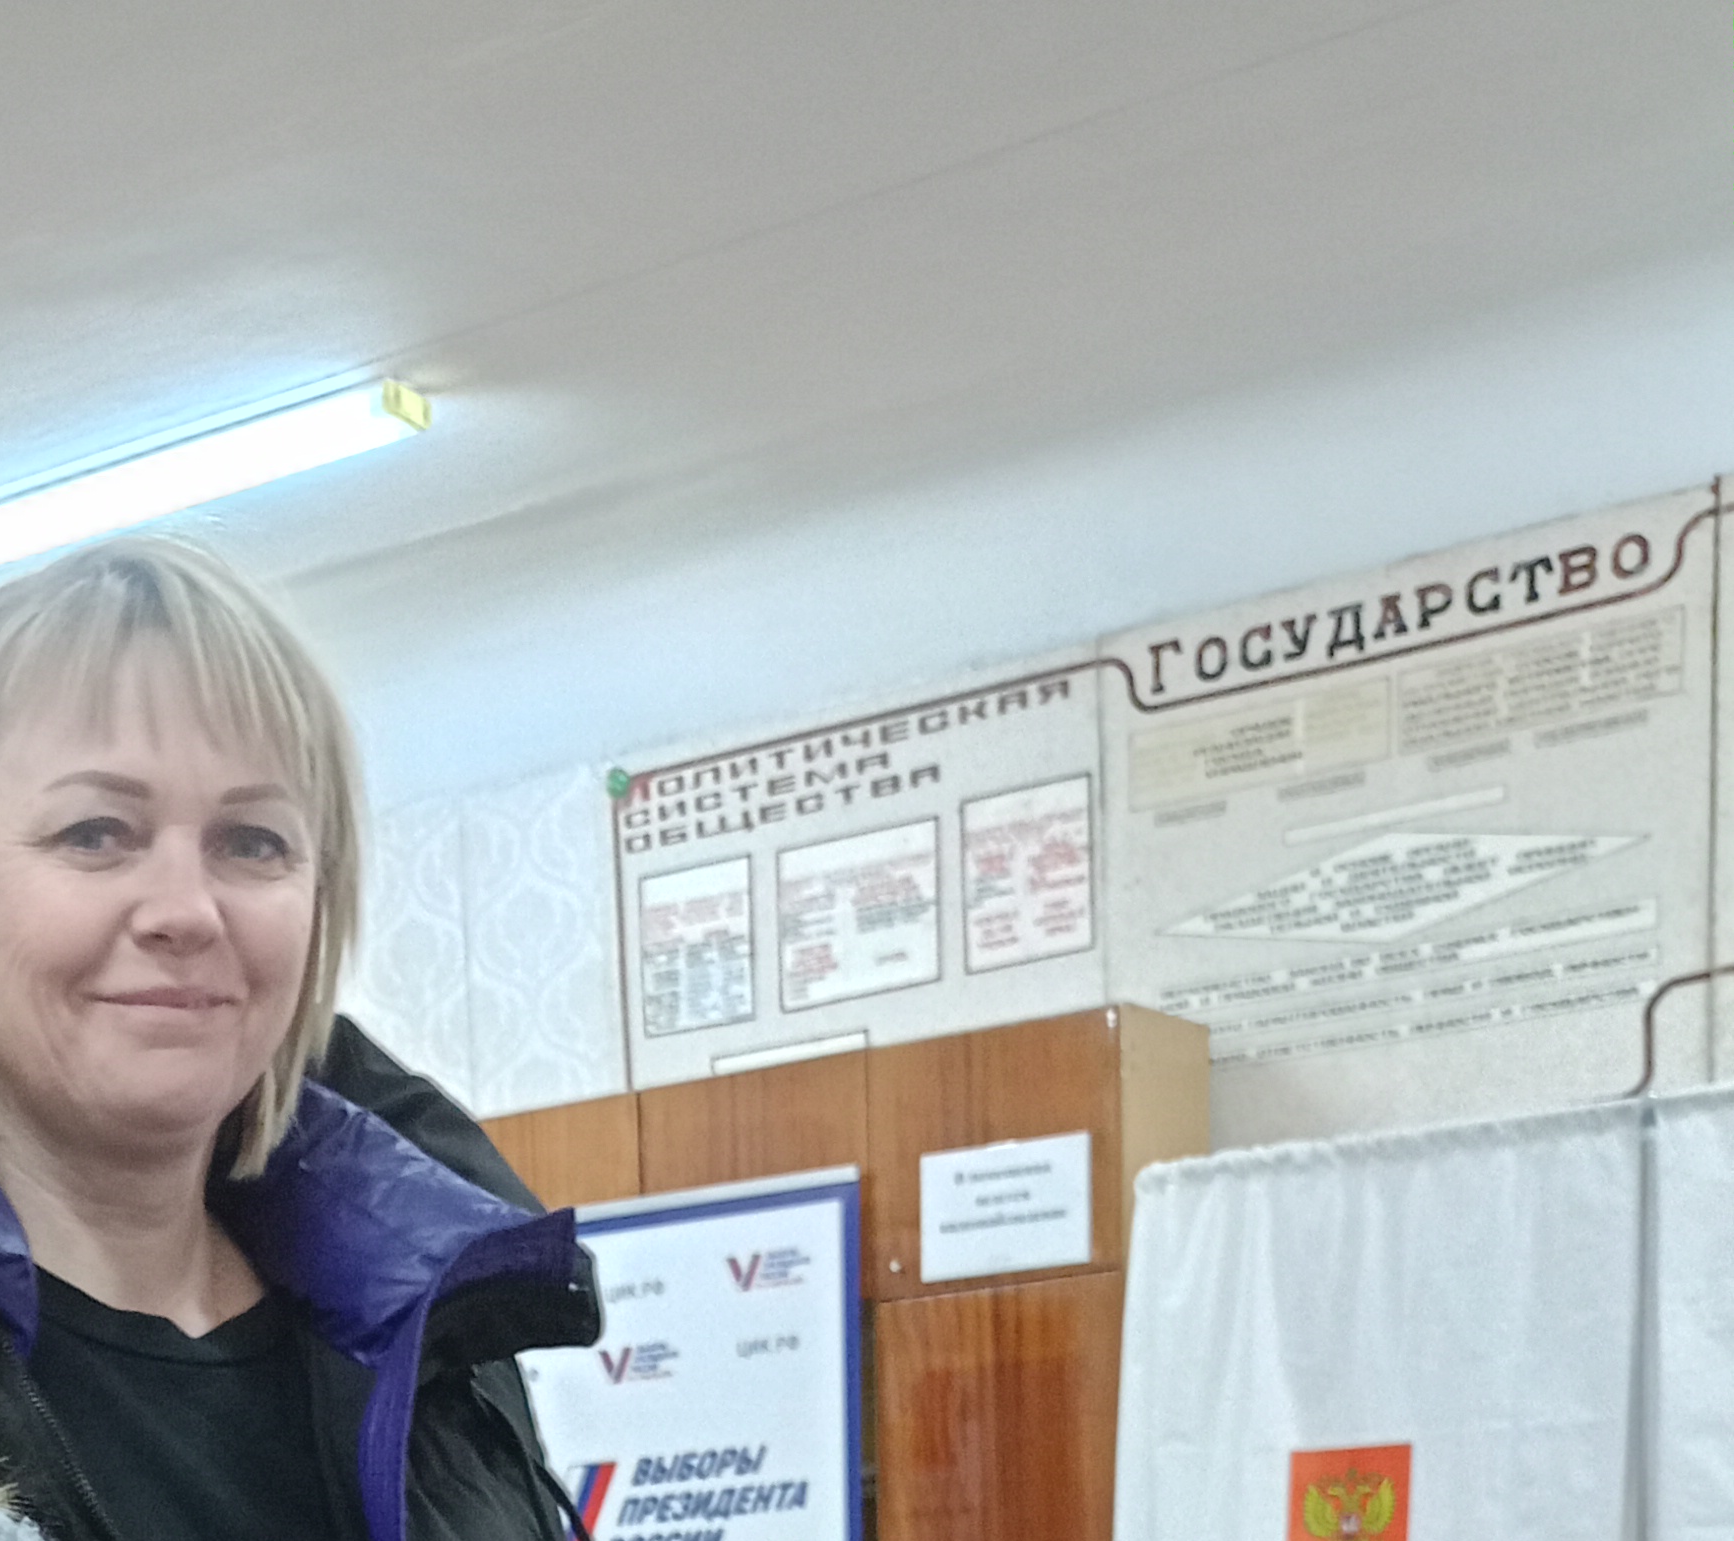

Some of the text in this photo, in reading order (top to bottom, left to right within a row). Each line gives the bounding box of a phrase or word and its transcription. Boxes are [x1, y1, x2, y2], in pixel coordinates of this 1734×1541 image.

[1147, 533, 1651, 695] ГОСУДАРСТВО
[630, 680, 1070, 802] ПОЛИТИЧЕСКАЯ
[625, 752, 891, 829] СИСТЕМА
[625, 763, 941, 853] ОБЩЕСТВА
[617, 1482, 808, 1527] ПРЕЗИДЕНТА
[632, 1445, 768, 1486] ВЫБОРЫ
